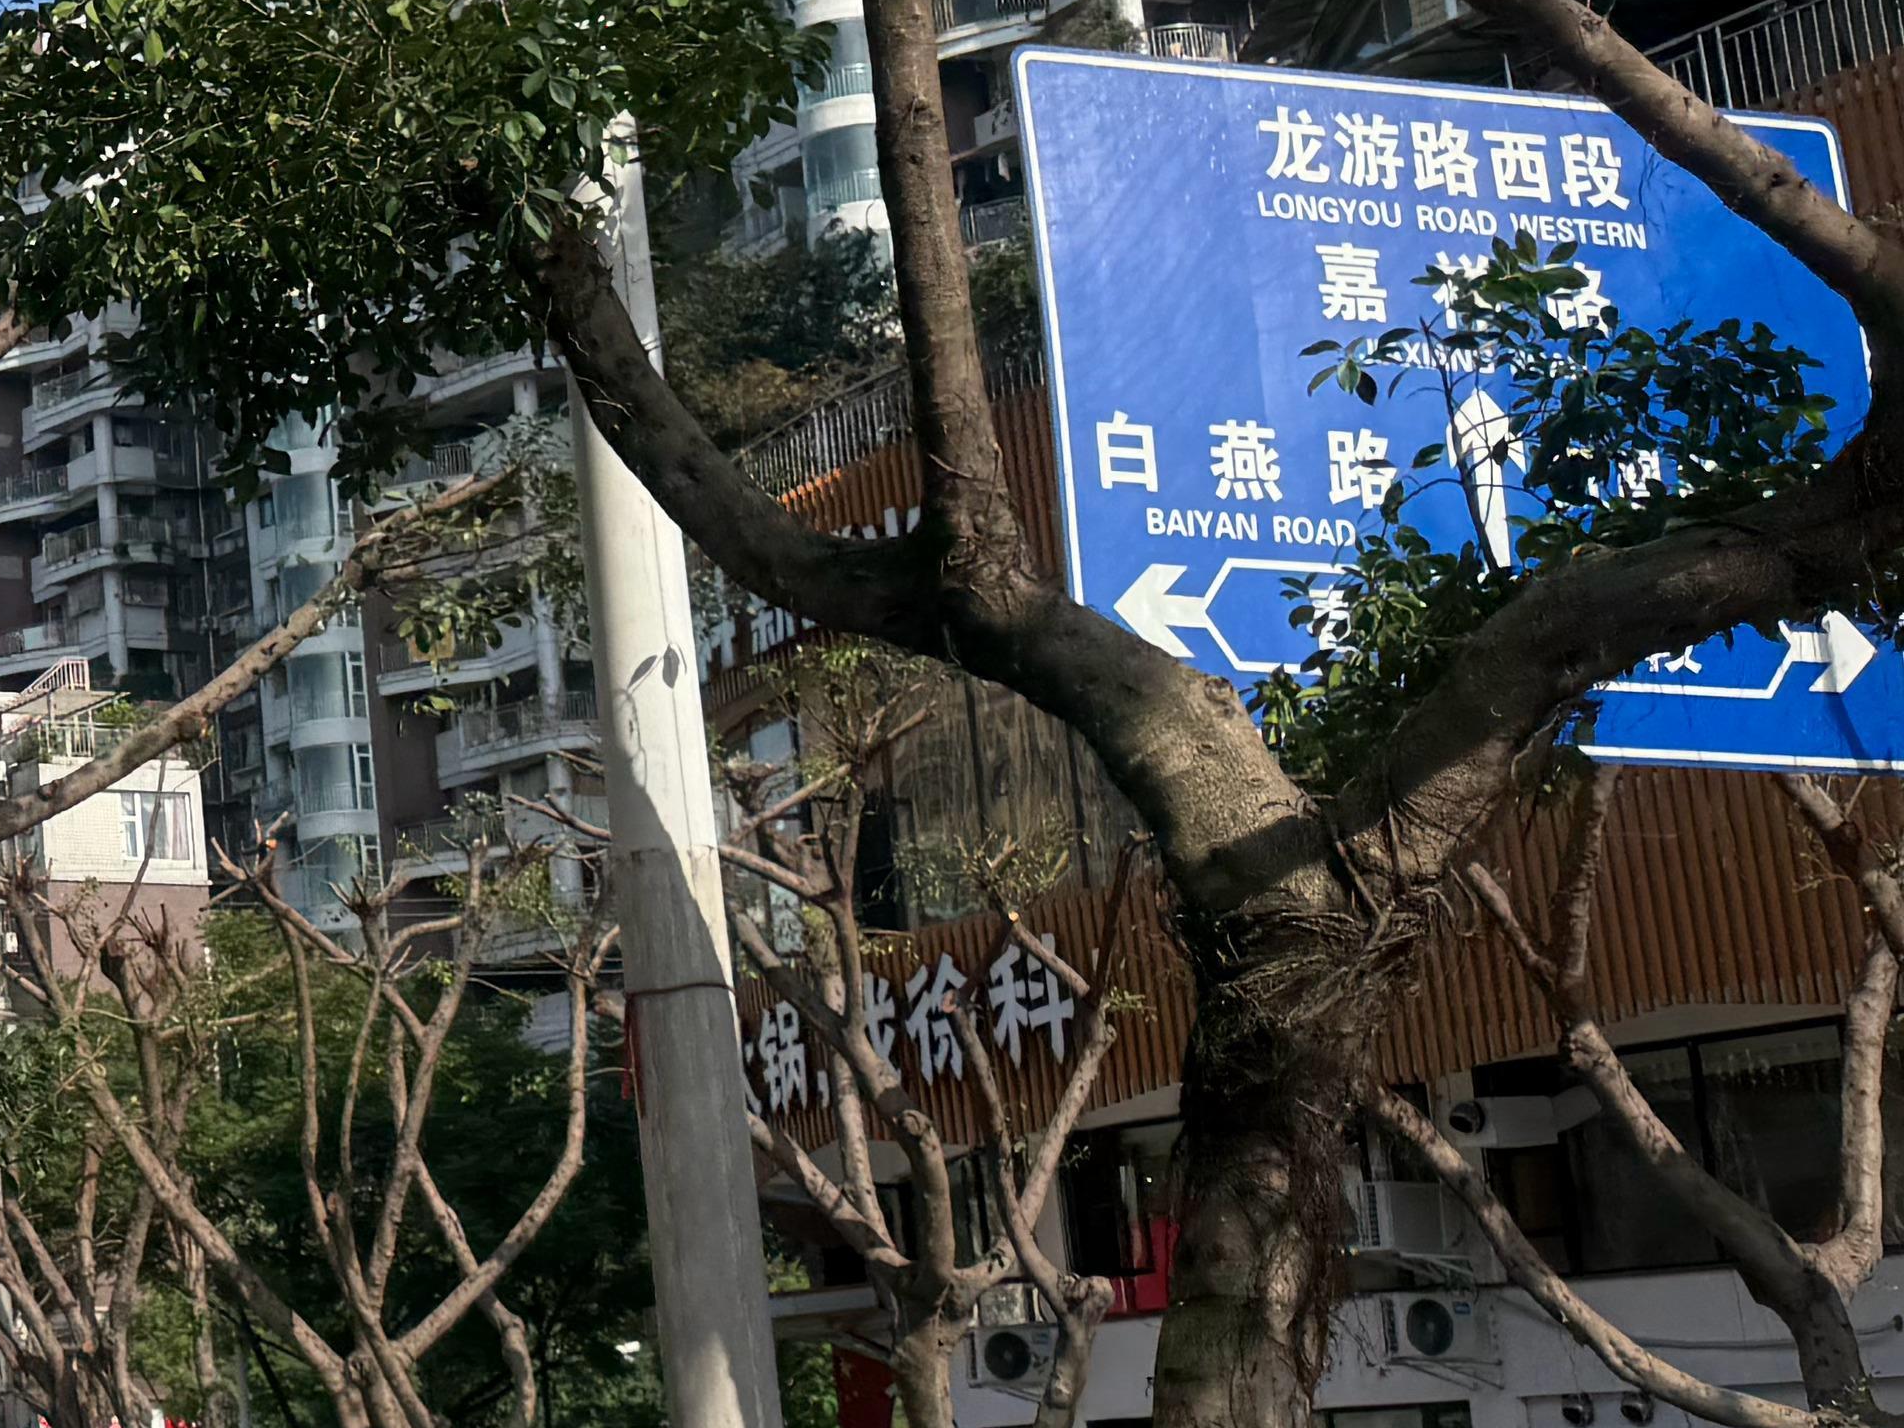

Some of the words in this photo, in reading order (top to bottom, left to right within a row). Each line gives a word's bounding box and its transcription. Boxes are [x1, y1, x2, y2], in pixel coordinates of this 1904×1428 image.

[1258, 105, 1631, 211] 龙游路西段
[1258, 191, 1402, 229] LONGYOU
[1417, 205, 1497, 236] ROAD
[1512, 213, 1647, 250] WESTERN
[1096, 411, 1398, 509] 白燕路
[1146, 508, 1258, 541] BAIYAN
[1273, 515, 1356, 546] ROAD
